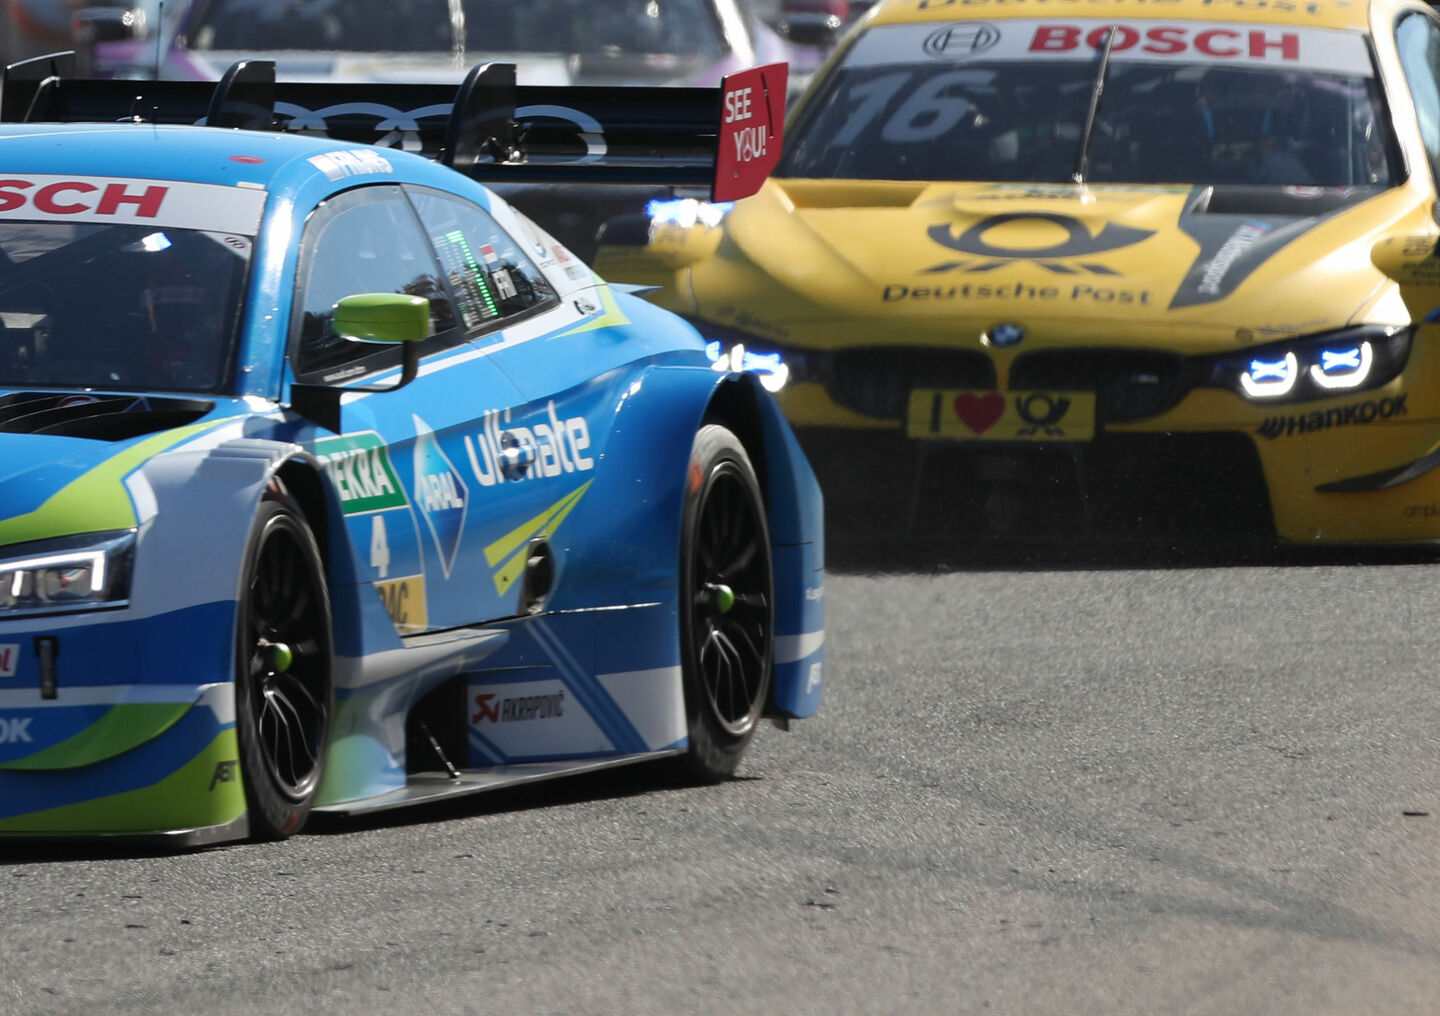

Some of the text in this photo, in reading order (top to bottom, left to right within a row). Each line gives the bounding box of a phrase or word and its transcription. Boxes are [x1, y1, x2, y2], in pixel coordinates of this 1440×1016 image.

[1028, 24, 1300, 61] BOSCH
[725, 87, 753, 123] SEE
[829, 68, 998, 149] 16
[882, 284, 1152, 306] Deutsche Post
[420, 471, 464, 512] ARAL
[371, 515, 390, 578] 4
